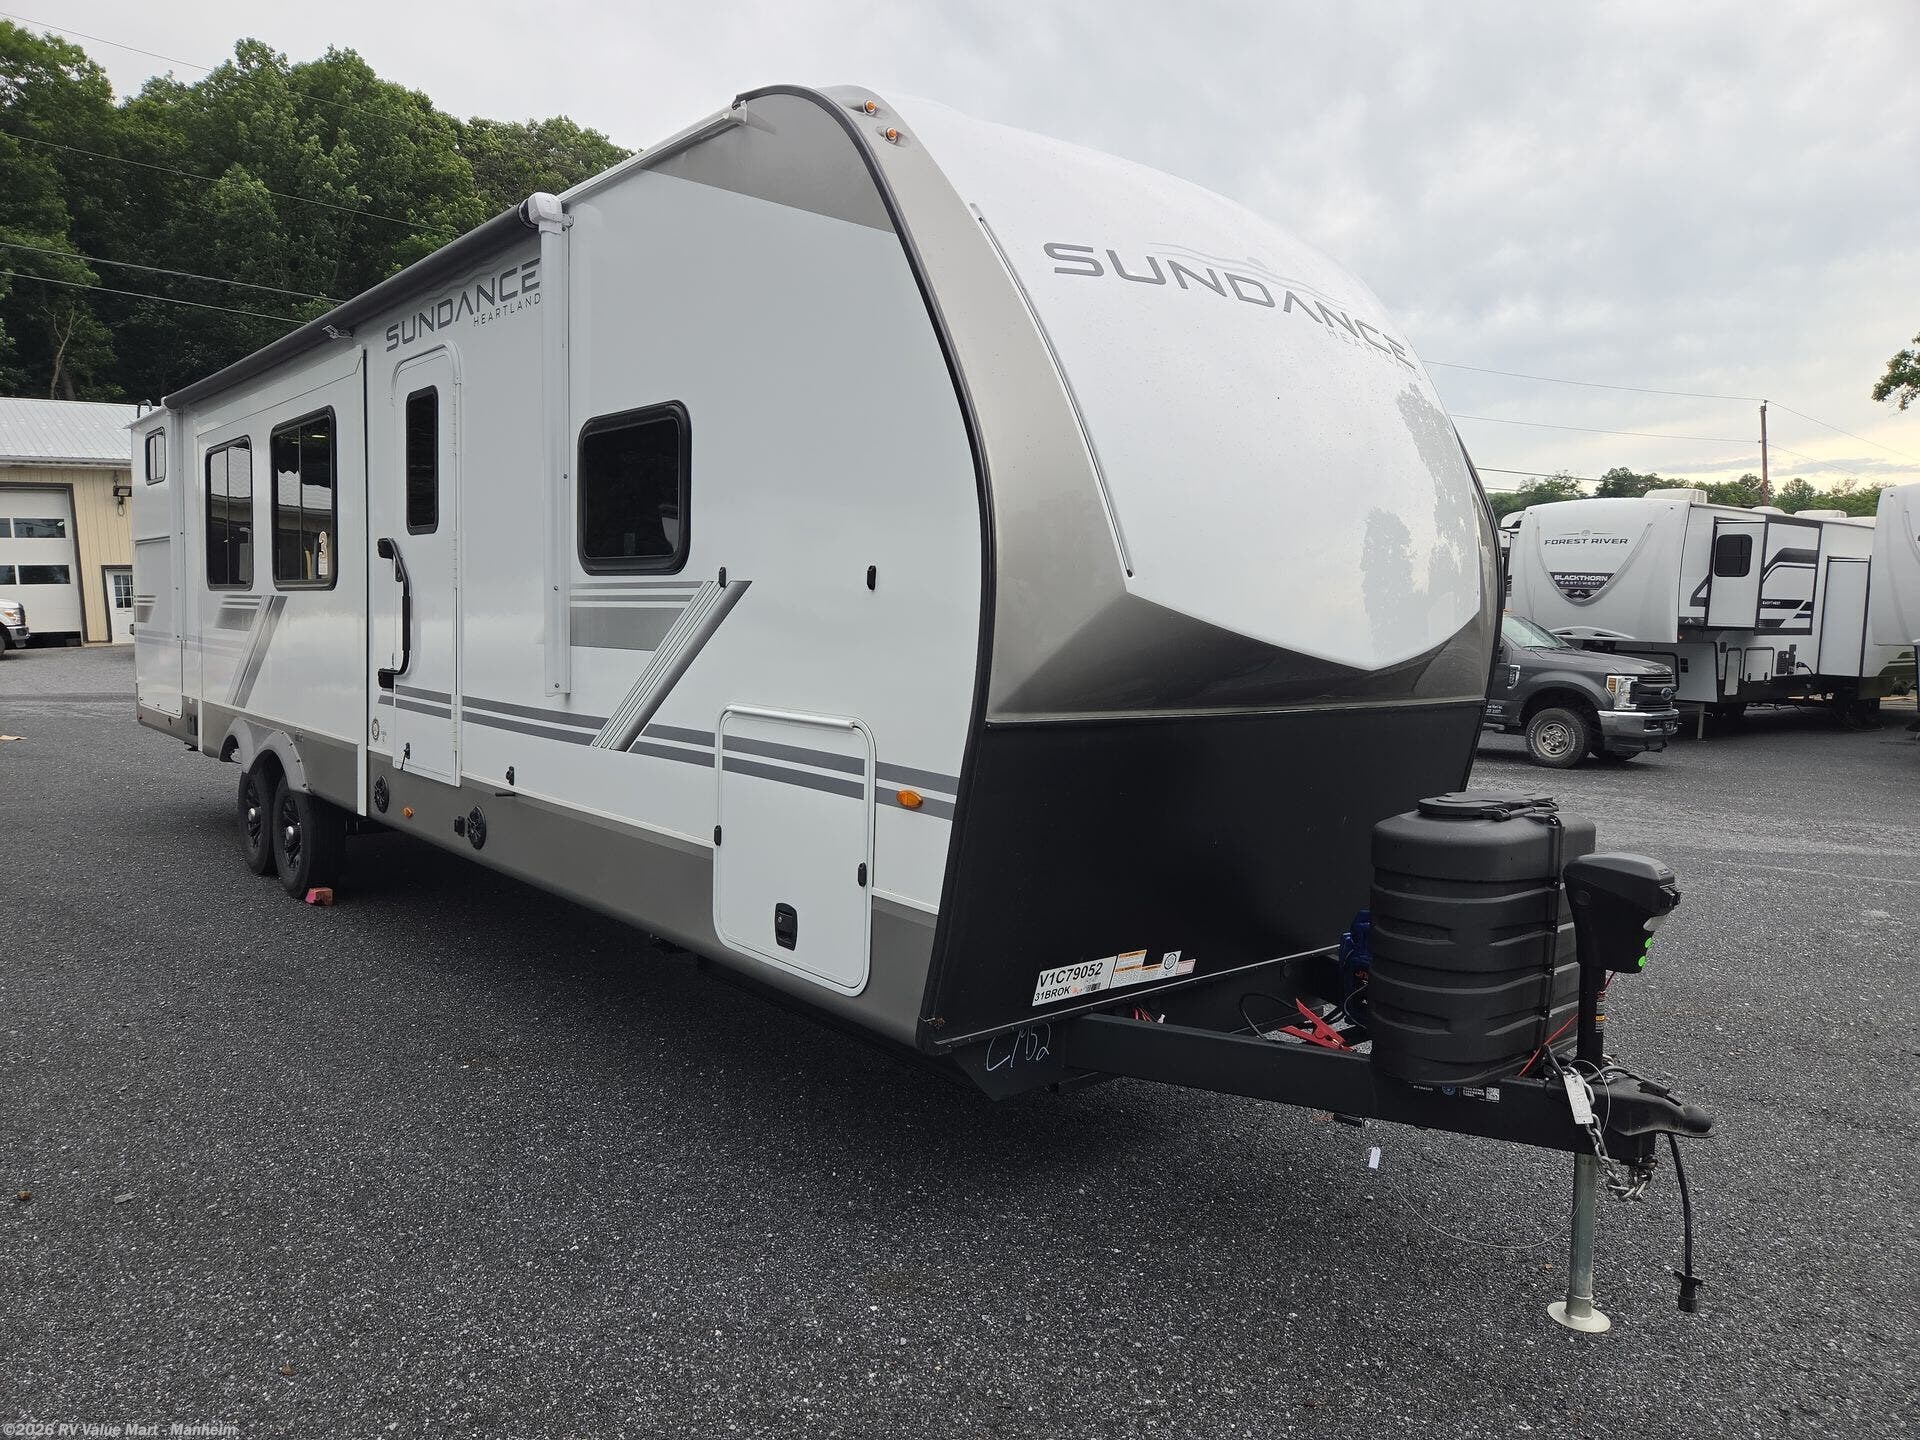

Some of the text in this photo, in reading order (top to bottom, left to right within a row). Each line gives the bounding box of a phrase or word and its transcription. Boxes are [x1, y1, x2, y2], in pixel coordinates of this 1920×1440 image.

[386, 257, 541, 352] SUNDANCE
[473, 292, 541, 327] HEARTLAND
[1043, 242, 1416, 370] SUNDANCE
[1040, 962, 1104, 988] V1C79052
[1034, 985, 1071, 1002] 31BROK
